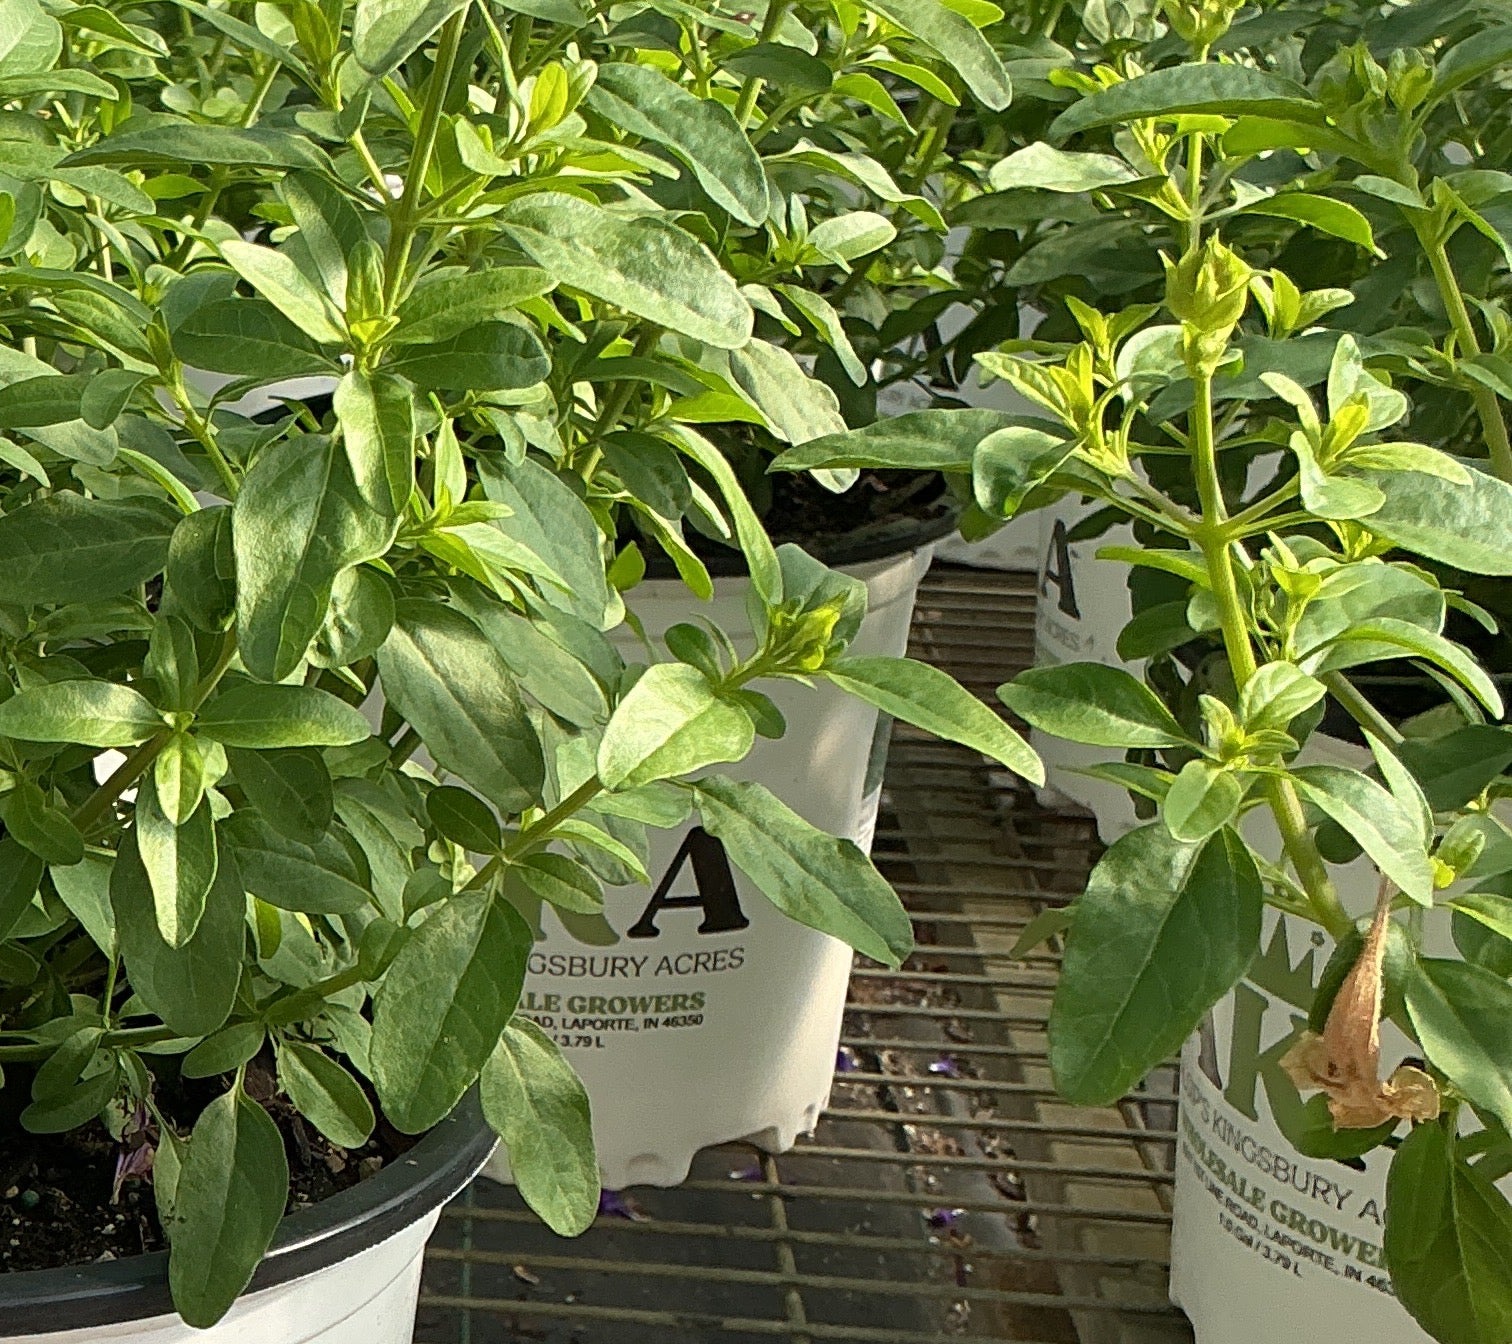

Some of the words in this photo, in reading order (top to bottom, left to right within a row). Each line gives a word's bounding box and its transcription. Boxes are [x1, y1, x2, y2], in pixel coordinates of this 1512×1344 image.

[528, 953, 648, 977] GSBURY
[654, 947, 744, 976] ACRES
[567, 991, 706, 1014] GROWERS
[644, 1017, 659, 1029] IN
[1269, 1199, 1385, 1269] GROWE
